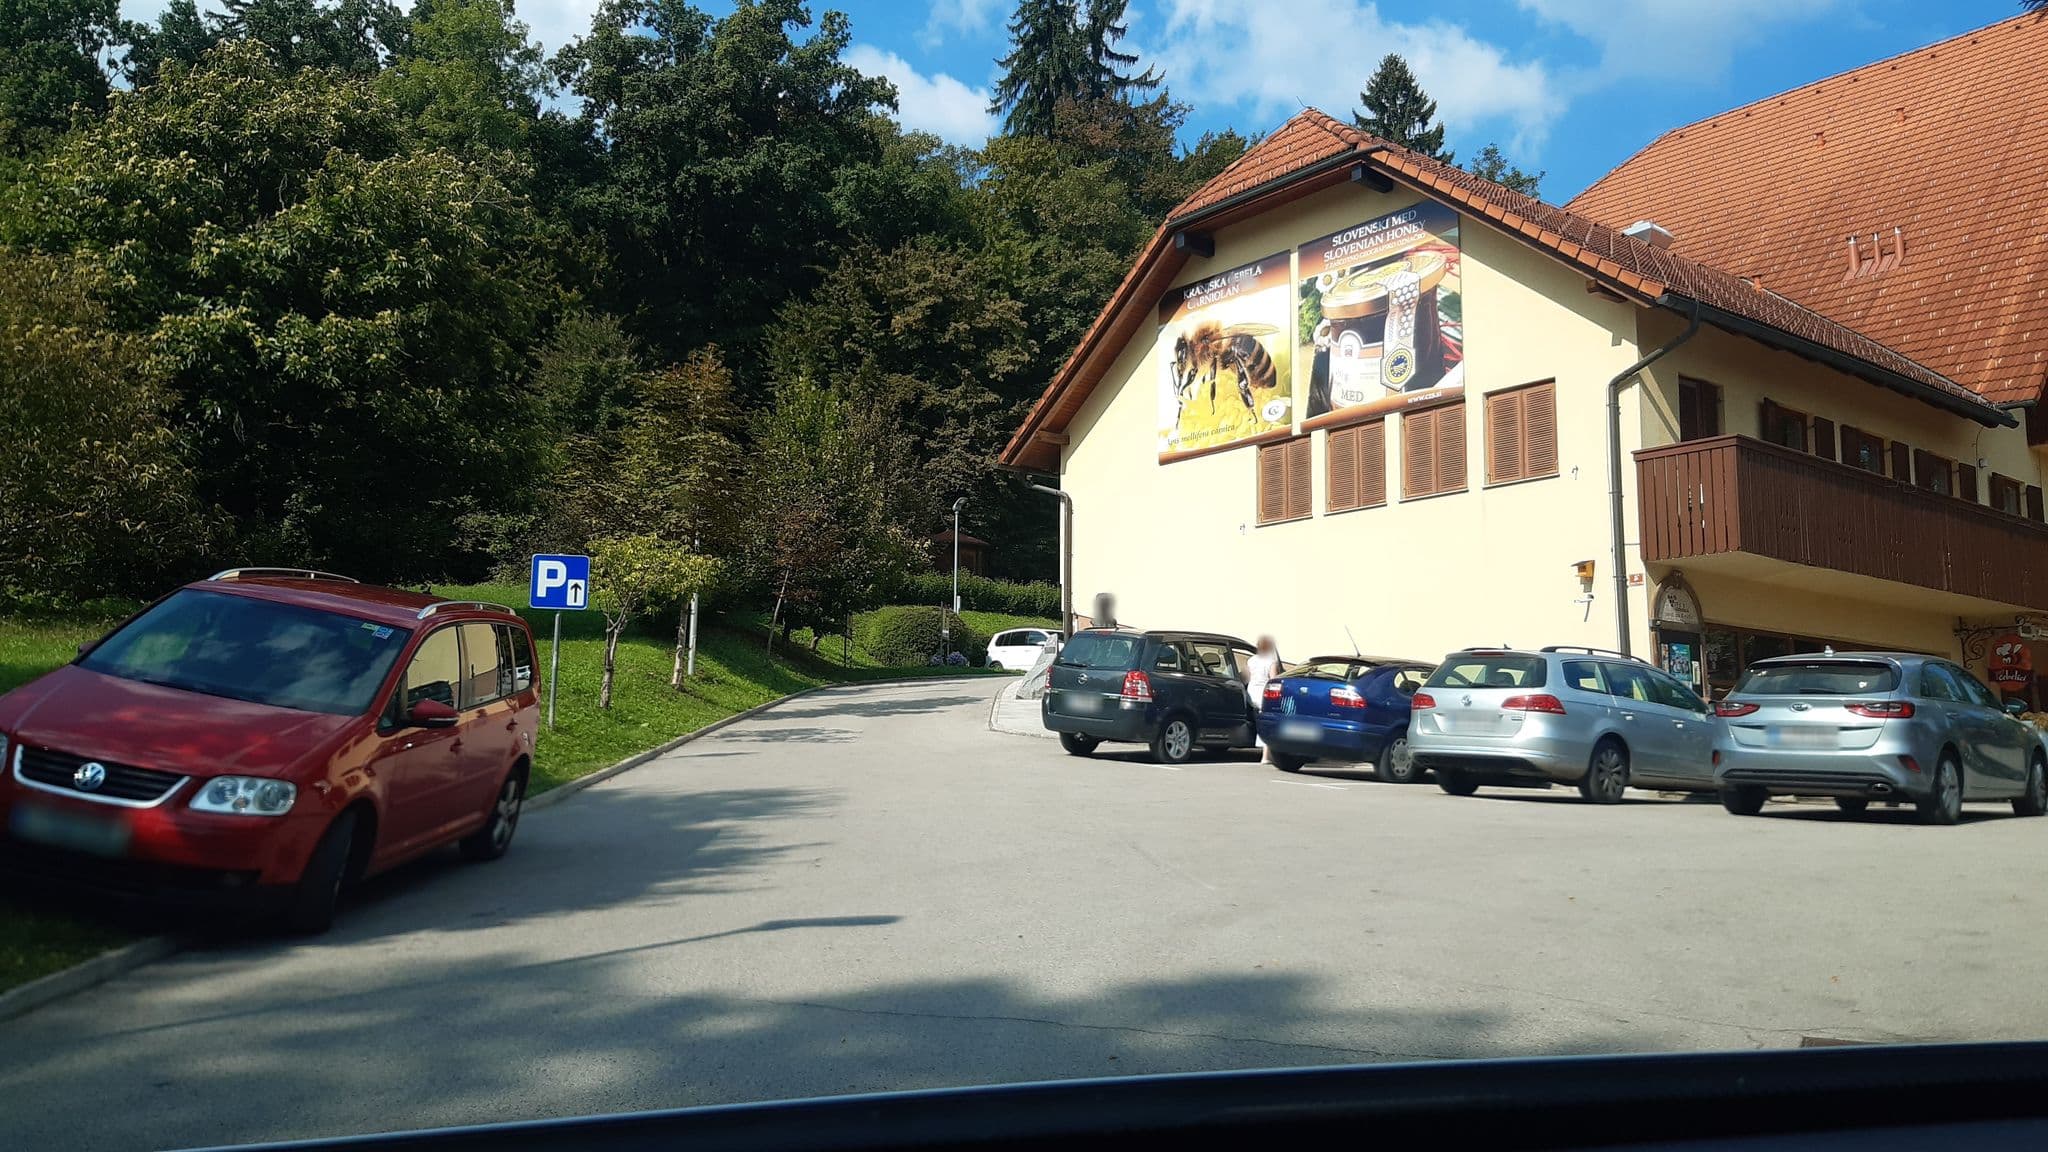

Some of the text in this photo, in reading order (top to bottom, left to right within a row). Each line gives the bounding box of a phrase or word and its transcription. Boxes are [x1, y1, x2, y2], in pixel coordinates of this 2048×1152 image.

[1324, 220, 1426, 263] SLOVENIAN HONEY
[1332, 209, 1417, 247] SLOVENSKI MED
[1183, 277, 1227, 300] KRANJSKA
[1341, 388, 1364, 403] MED
[537, 560, 567, 597] P
